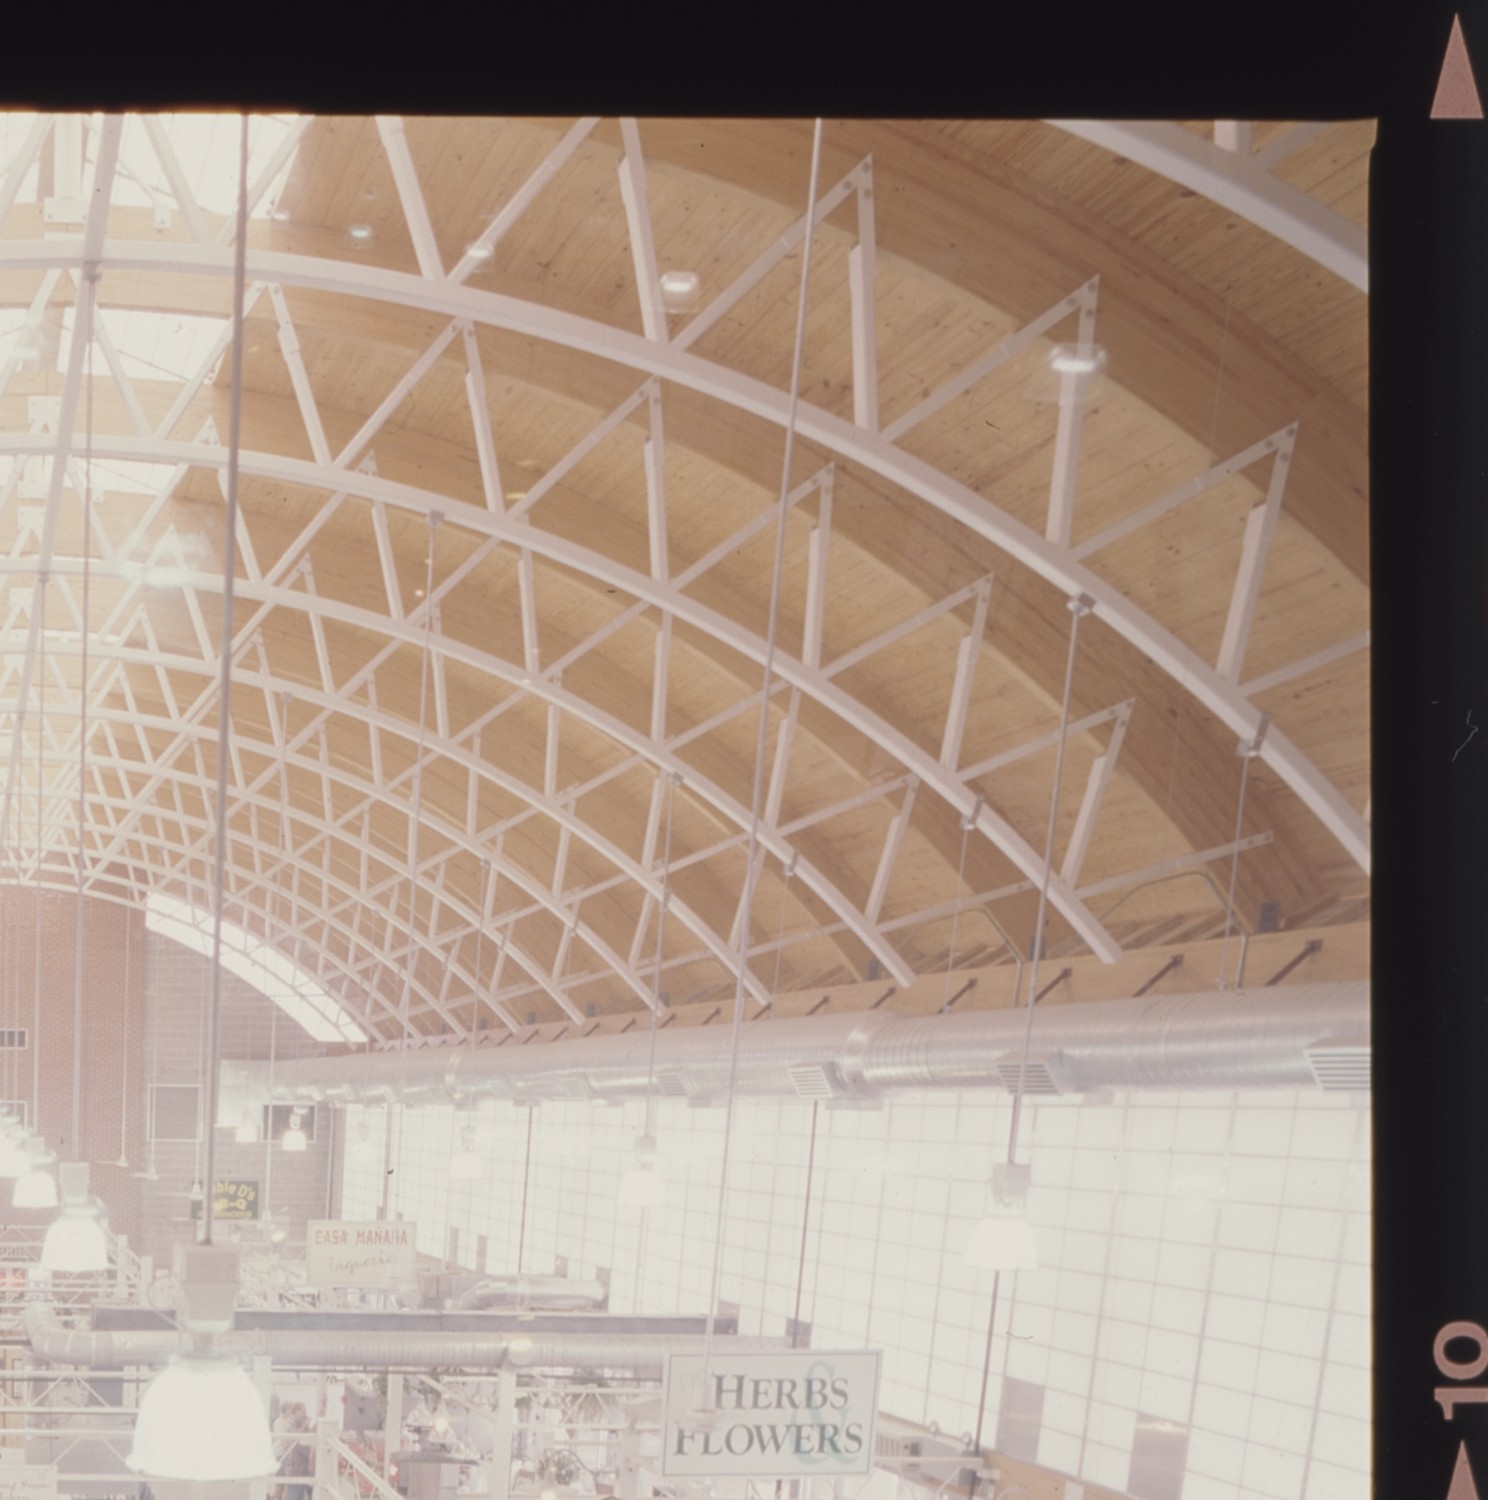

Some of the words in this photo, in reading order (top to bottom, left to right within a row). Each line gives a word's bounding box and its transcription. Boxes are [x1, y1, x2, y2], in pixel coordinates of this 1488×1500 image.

[315, 1229, 348, 1245] CASA
[1433, 1321, 1488, 1421] 10
[711, 1374, 849, 1411] HERBS
[673, 1421, 863, 1456] FLOWERS
